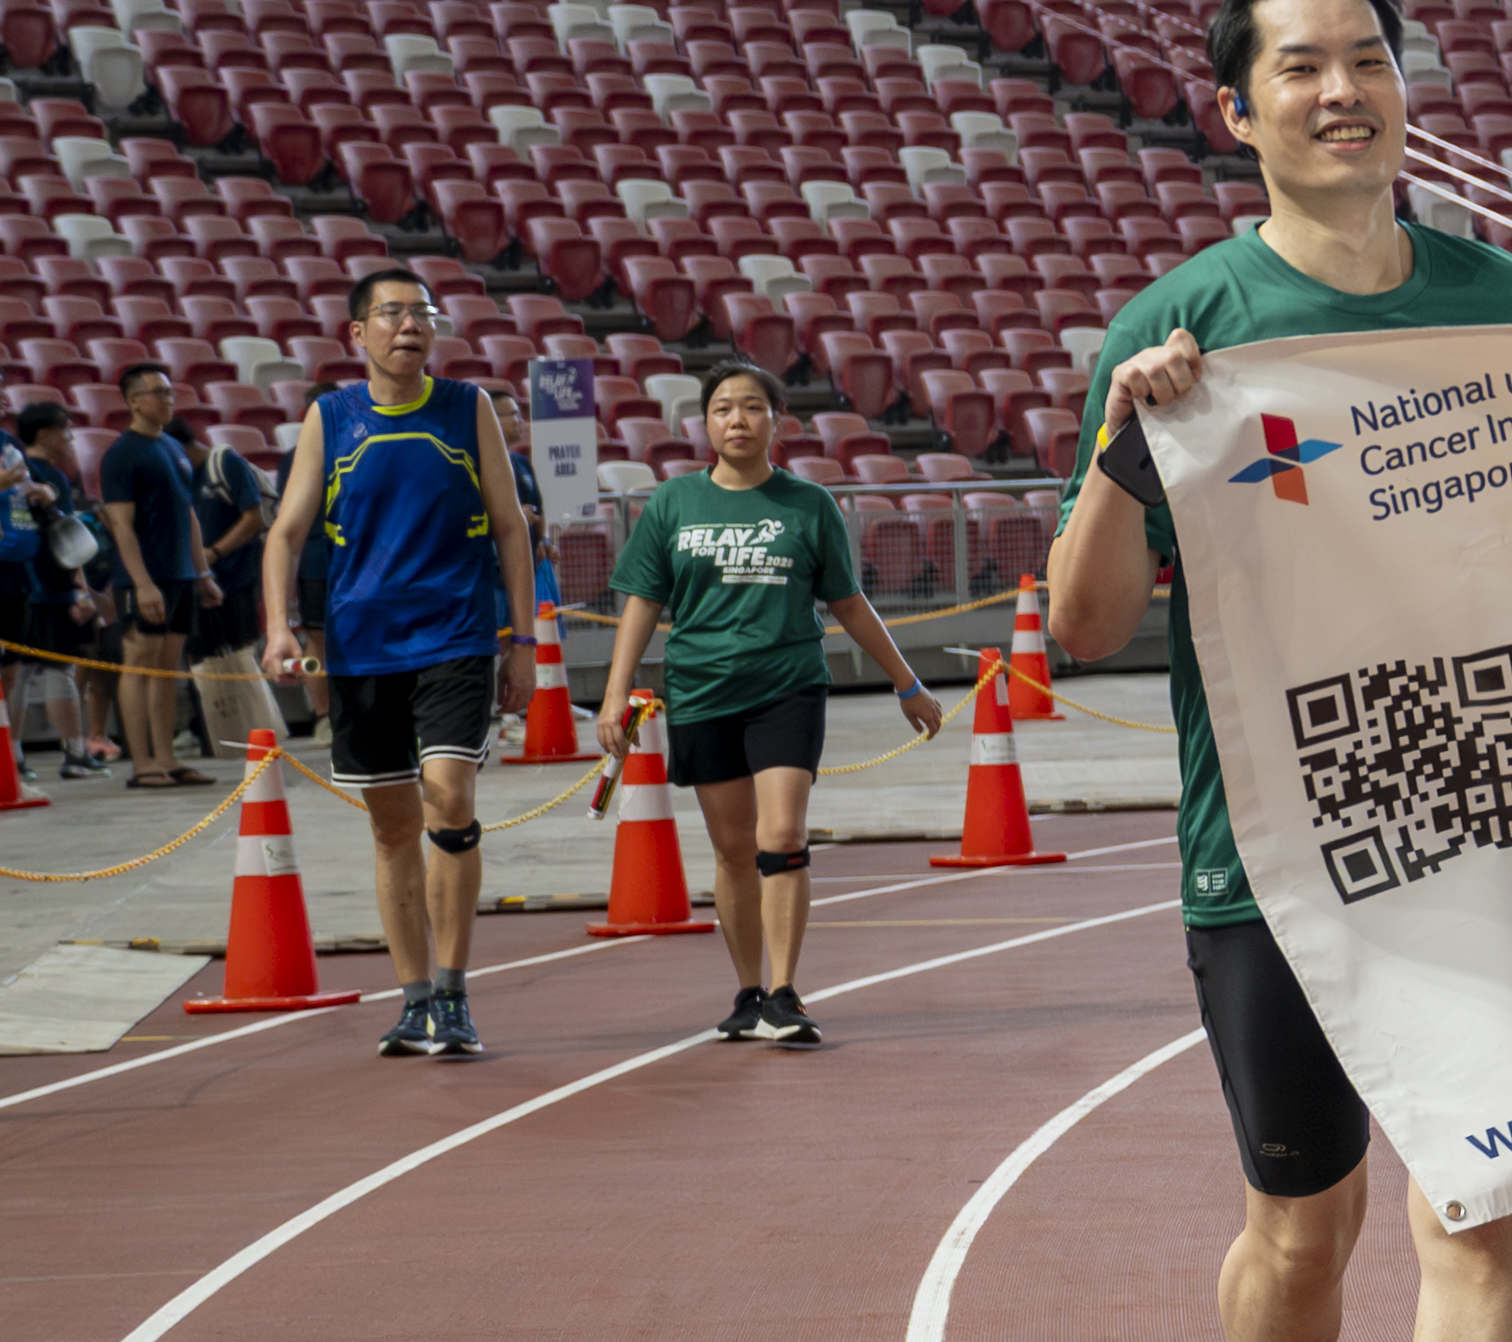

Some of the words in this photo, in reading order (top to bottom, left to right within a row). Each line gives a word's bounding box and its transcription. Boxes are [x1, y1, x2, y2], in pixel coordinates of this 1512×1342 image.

[1350, 372, 1497, 436] National
[548, 444, 582, 461] PRAYER
[1360, 425, 1480, 477] Cancer
[554, 462, 578, 478] AREA
[678, 528, 755, 552] RELAY
[691, 546, 716, 558] FOR
[714, 546, 768, 567] LIFE
[722, 566, 776, 575] SINGAPORE
